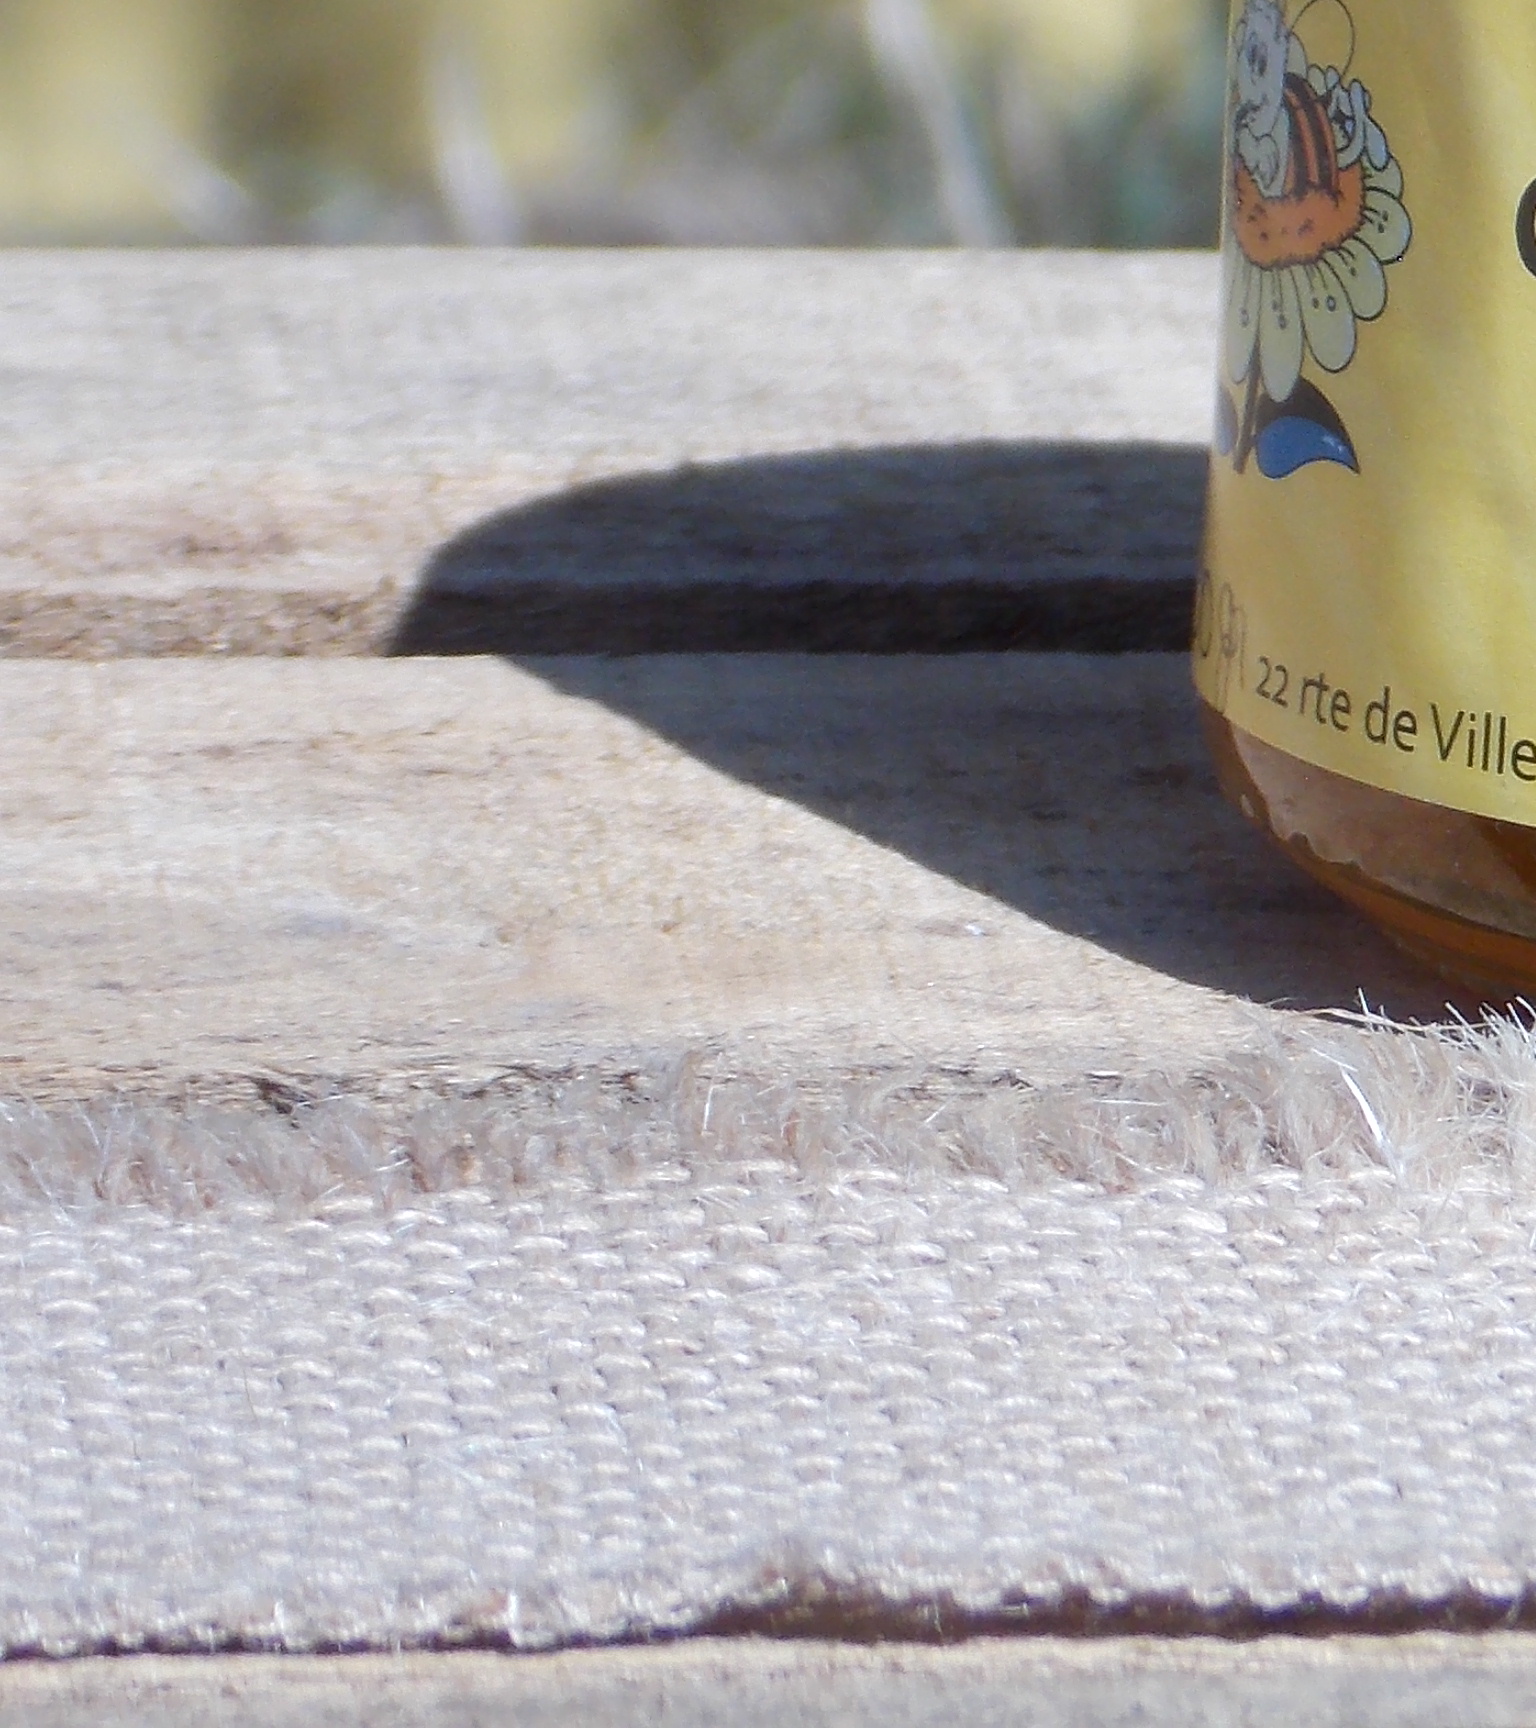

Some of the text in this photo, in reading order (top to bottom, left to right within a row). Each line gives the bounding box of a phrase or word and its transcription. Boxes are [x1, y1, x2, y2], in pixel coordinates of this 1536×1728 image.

[1256, 655, 1289, 708] 22
[1299, 672, 1353, 733] rte
[1363, 685, 1419, 754] de
